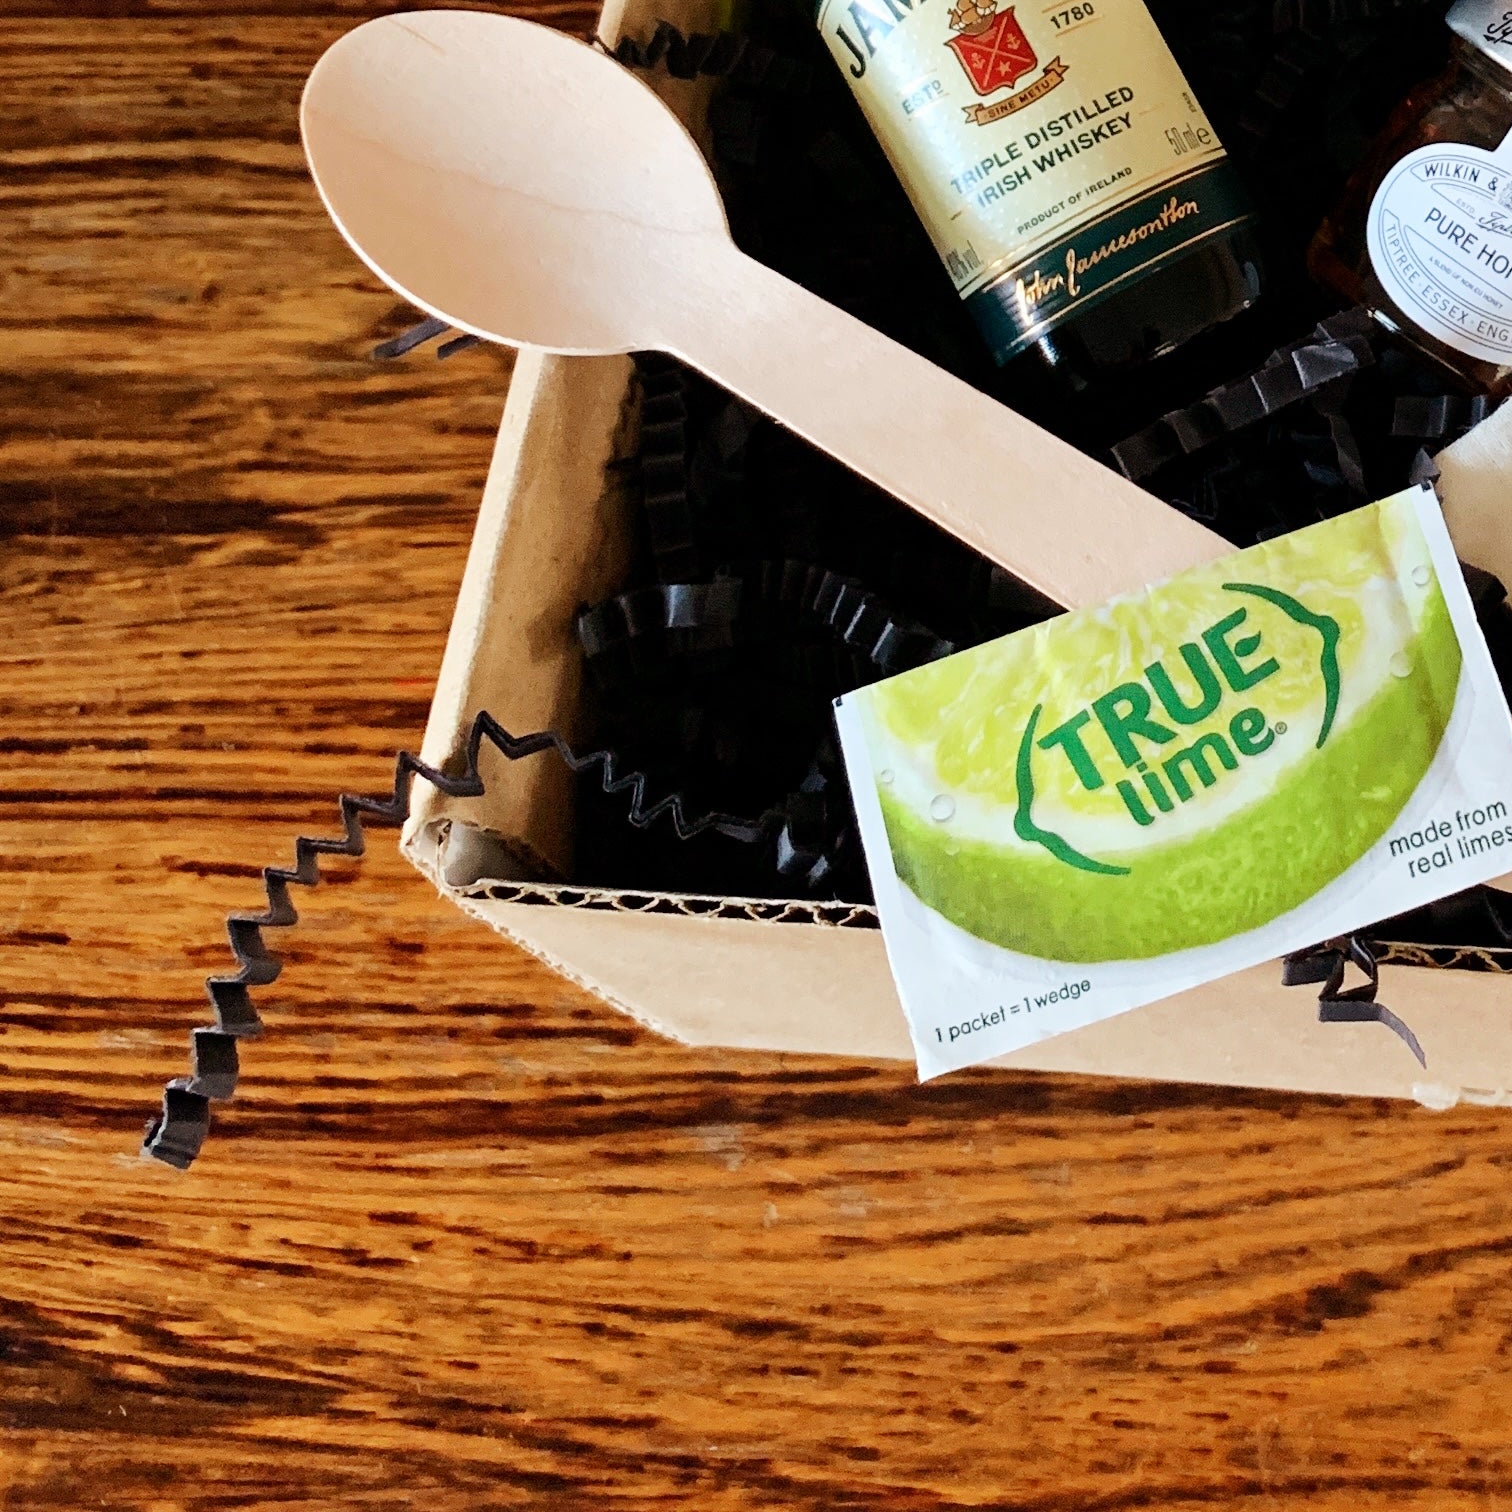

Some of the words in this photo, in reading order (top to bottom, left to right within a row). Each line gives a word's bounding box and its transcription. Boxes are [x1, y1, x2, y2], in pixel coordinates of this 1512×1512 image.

[1050, 2, 1095, 29] 1780
[987, 101, 1016, 118] SINE
[1018, 79, 1051, 103] METU
[950, 142, 1019, 197] TRIPLE
[1028, 85, 1135, 150] DISTILLED
[977, 165, 1033, 208] IRISH
[1032, 114, 1134, 173] WHISKEY
[1017, 202, 1065, 235] PRODUCT
[1068, 191, 1082, 205] OF
[1085, 167, 1133, 197] IRELAND
[1425, 162, 1480, 182] WILKIN
[1488, 176, 1499, 191] &
[1424, 207, 1479, 254] PURE
[1386, 223, 1417, 285] TIPTREE
[1421, 285, 1467, 325] ESSEX
[1037, 607, 1280, 790] TRUE
[1389, 820, 1453, 856] made
[1455, 801, 1507, 831] from
[1408, 843, 1453, 878] real
[935, 1028, 942, 1042] 1
[949, 1006, 1006, 1042] packet
[1010, 1004, 1020, 1014] =
[1034, 980, 1091, 1008] wedge
